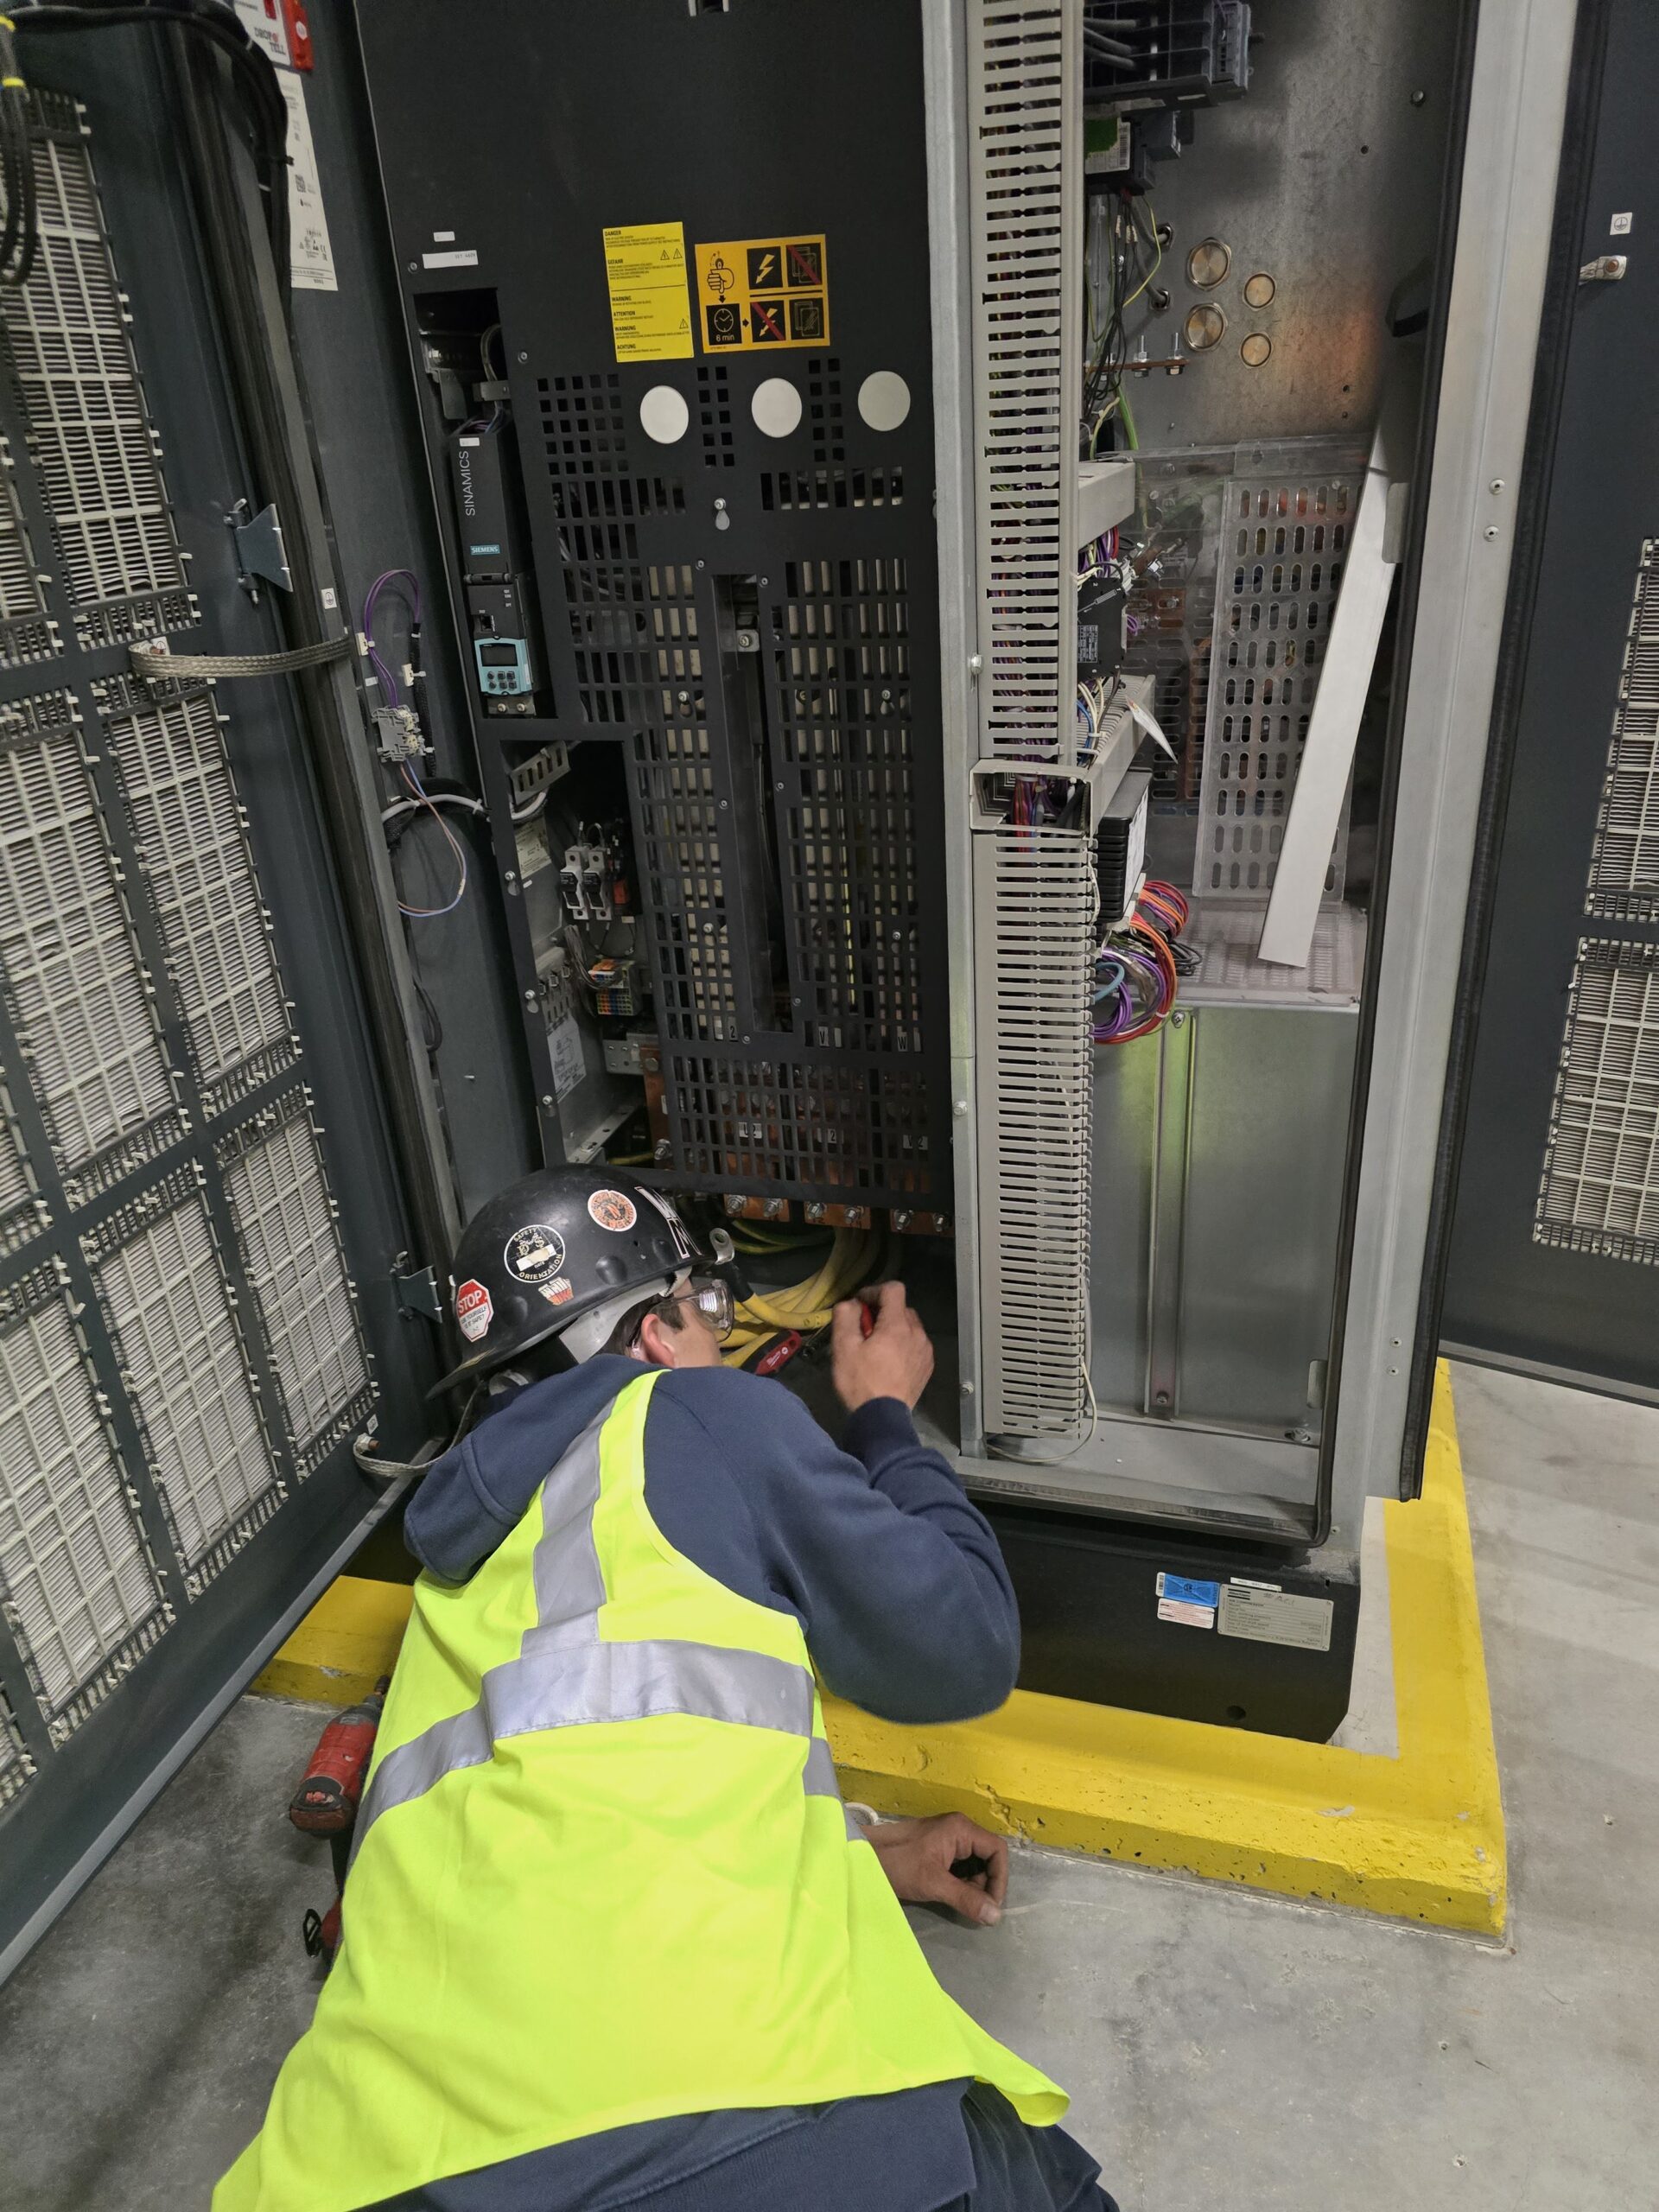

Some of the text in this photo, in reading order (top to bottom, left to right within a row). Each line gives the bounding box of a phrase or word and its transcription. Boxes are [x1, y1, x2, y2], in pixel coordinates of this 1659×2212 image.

[459, 450, 476, 517] SINAMICS
[471, 545, 499, 554] SIEMENS
[729, 1025, 736, 1038] 2
[819, 1030, 825, 1044] V
[898, 1036, 907, 1050] W
[514, 1227, 537, 1243] SAFETY
[518, 1253, 563, 1280] ORIENTATION
[458, 1289, 482, 1313] STOP
